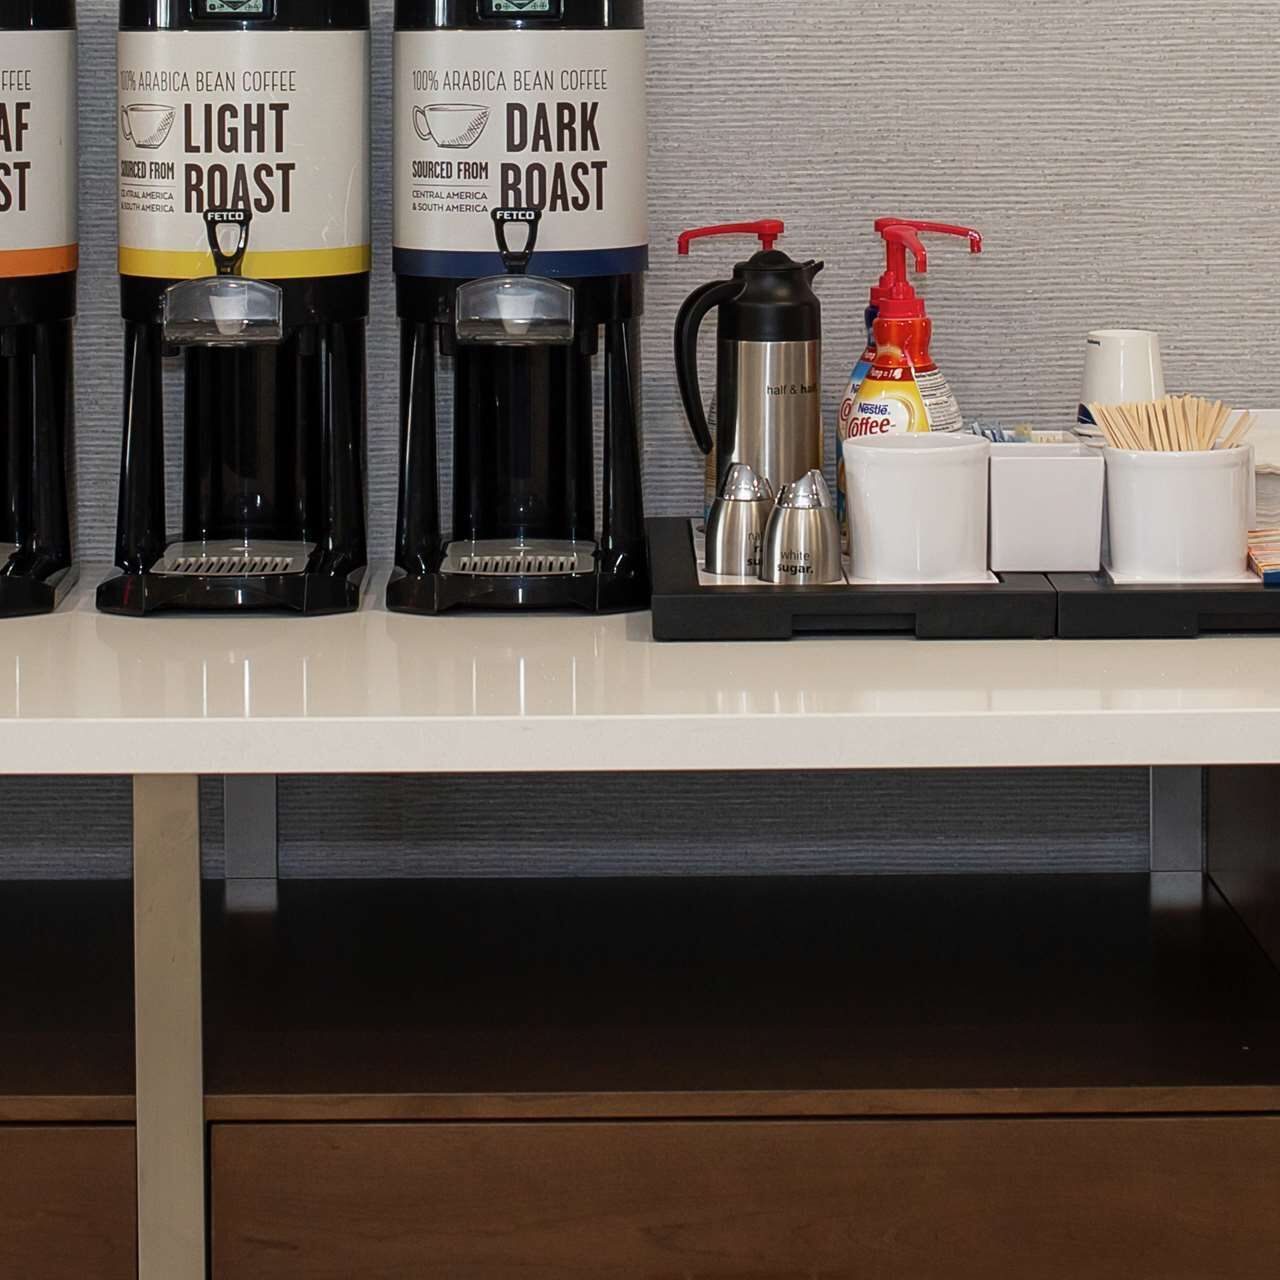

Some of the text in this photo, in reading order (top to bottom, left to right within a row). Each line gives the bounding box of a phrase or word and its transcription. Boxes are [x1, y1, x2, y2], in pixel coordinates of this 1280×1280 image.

[138, 71, 190, 92] ARABICA
[197, 71, 236, 92] BEAN
[242, 71, 296, 92] COFFEE
[412, 70, 608, 93] 100% ARABICA BEAN COFFEE
[184, 103, 289, 153] LIGHT
[506, 102, 600, 152] DARK
[149, 161, 175, 179] FROM
[412, 160, 489, 180] SOURCED FROM
[185, 163, 296, 213] ROAST
[500, 161, 608, 212] ROAST
[141, 191, 174, 200] AMERICA
[412, 190, 488, 200] CENTRAL AMERICA
[141, 203, 175, 212] AMERICA
[418, 203, 444, 211] SOUTH
[445, 204, 489, 212] AMERICA
[207, 211, 244, 221] FETCO
[496, 211, 536, 220] FETCO
[766, 384, 790, 396] half
[789, 385, 797, 394] &
[781, 549, 810, 560] white
[777, 563, 814, 576] sugar.
